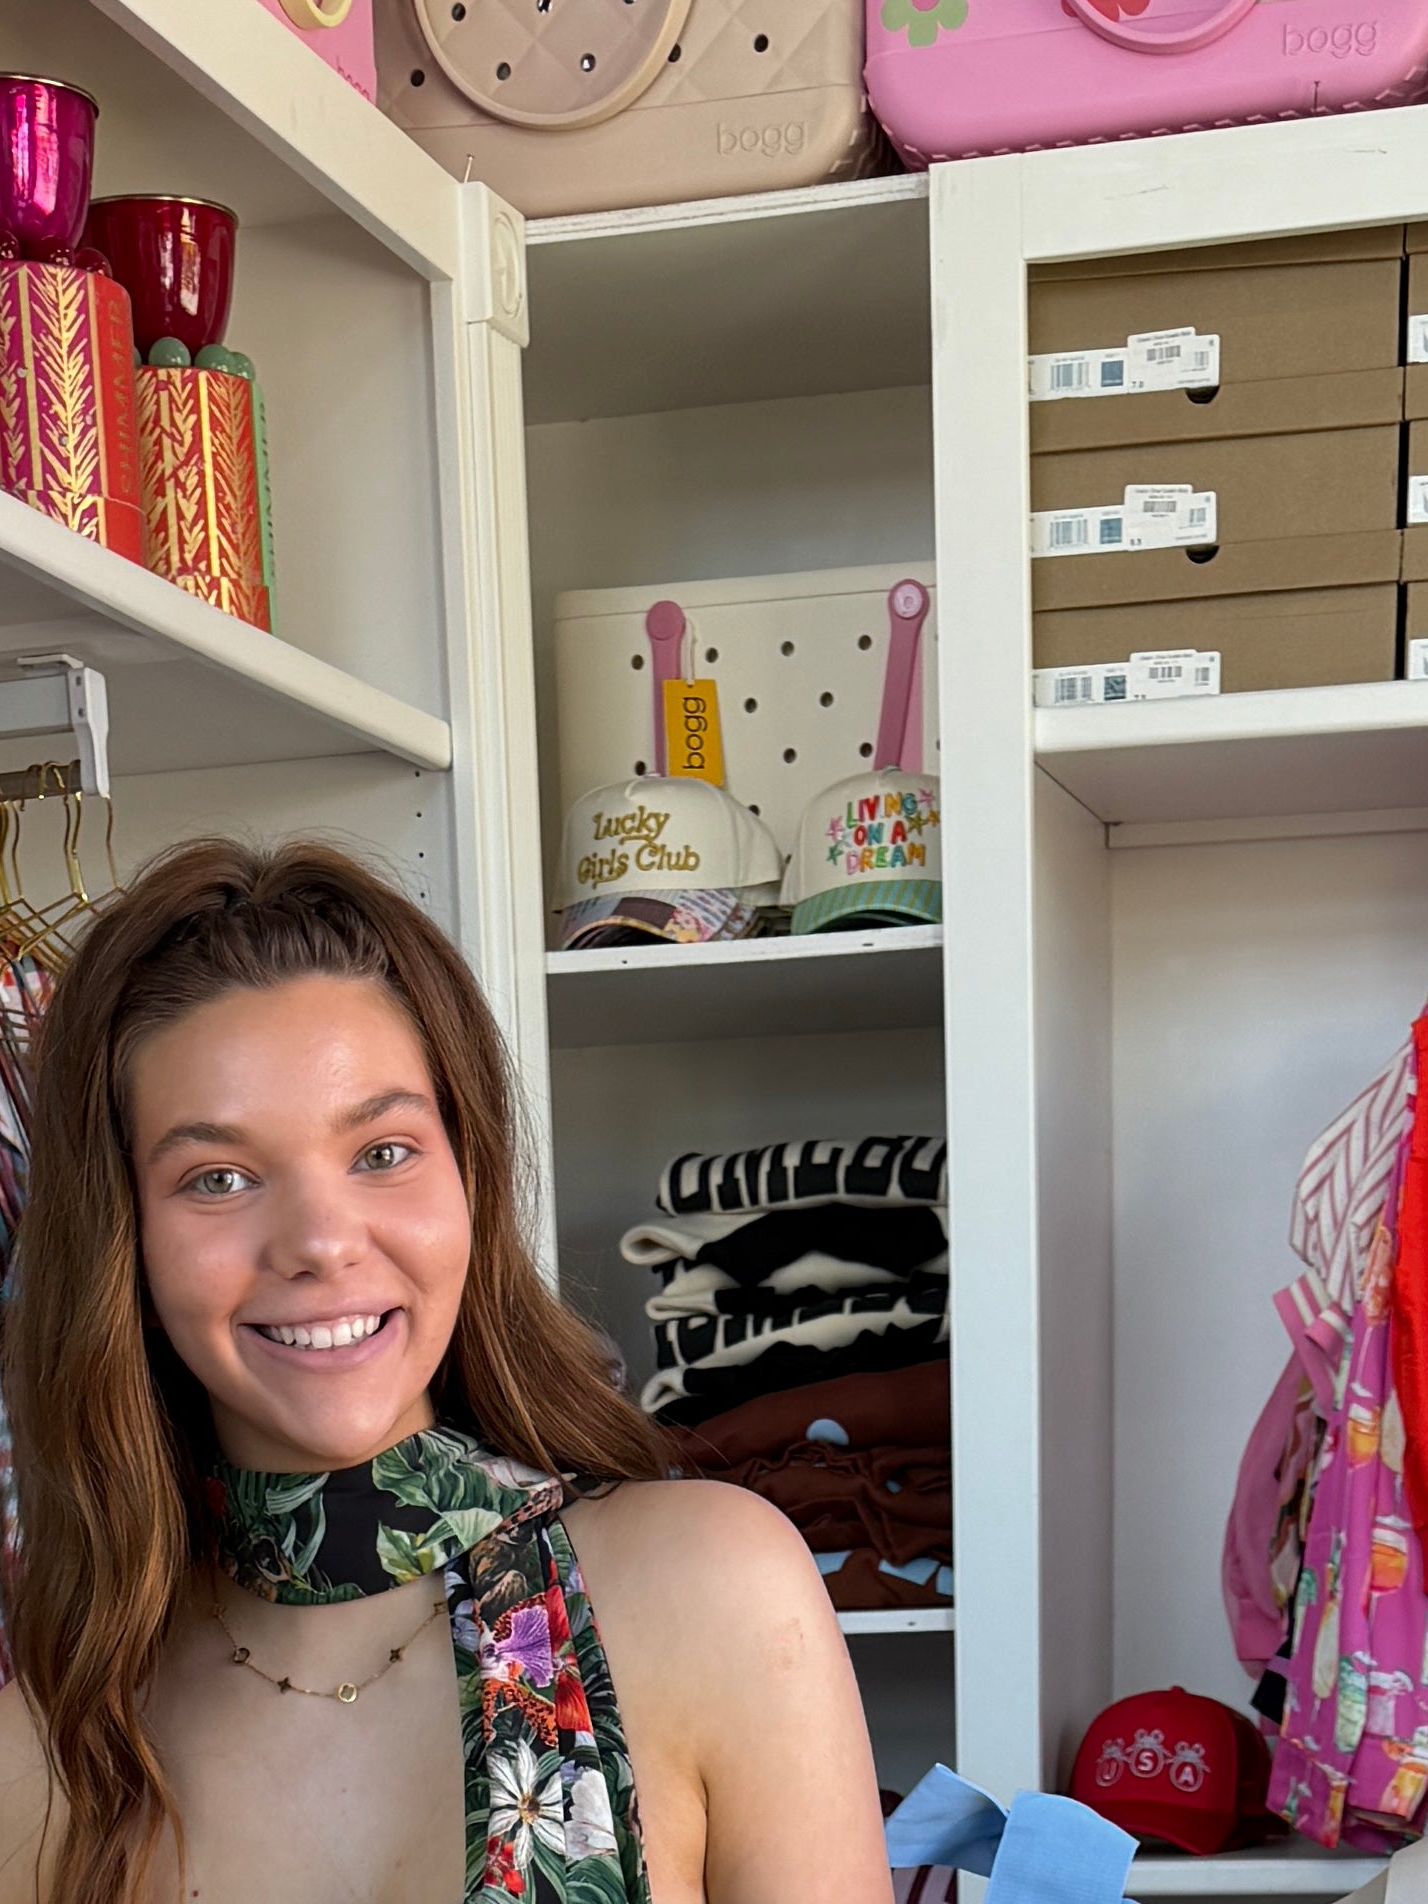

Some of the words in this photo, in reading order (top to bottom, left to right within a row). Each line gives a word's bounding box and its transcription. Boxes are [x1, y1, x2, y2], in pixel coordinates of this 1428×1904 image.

[1283, 21, 1377, 59] bogg
[716, 120, 805, 159] bogg
[681, 696, 708, 770] bogg
[592, 804, 671, 846] Lucky
[853, 822, 884, 847] ON
[889, 820, 908, 845] A
[577, 847, 630, 890] Girls
[635, 840, 701, 872] Club
[845, 842, 927, 876] DREAM
[1101, 1750, 1196, 1786] USA
